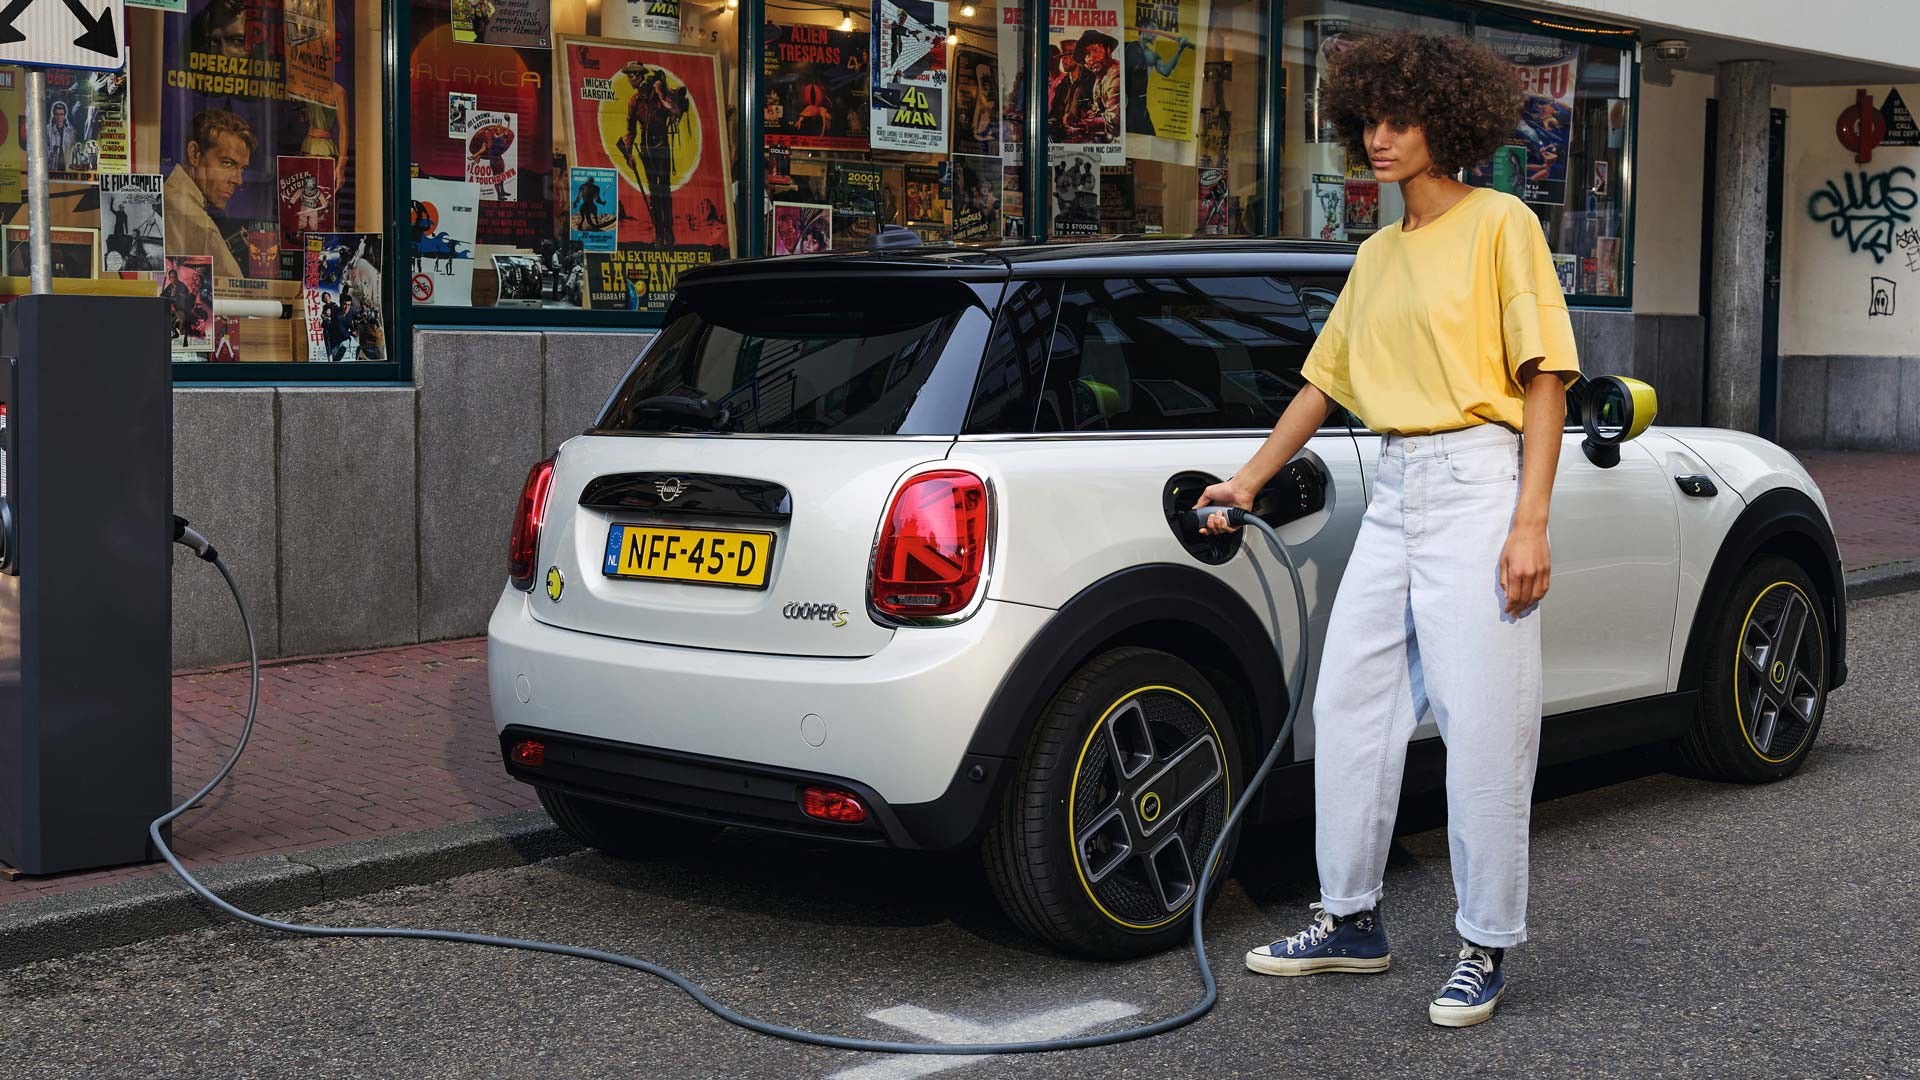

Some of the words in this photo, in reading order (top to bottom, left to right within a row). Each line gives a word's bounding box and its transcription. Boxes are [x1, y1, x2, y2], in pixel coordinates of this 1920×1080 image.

[1067, 10, 1118, 26] MARIA
[791, 25, 829, 44] ALIEN
[778, 43, 841, 64] TRESPASS
[189, 52, 281, 79] OPERAZIONE
[167, 70, 288, 100] CONTROSPIONAG
[410, 64, 541, 88] ALAXICA
[585, 78, 613, 89] MICKEY
[1511, 64, 1569, 99] G-FU
[582, 88, 615, 100] HARGITAY
[902, 86, 929, 109] 4D
[894, 109, 937, 127] MAN
[1004, 143, 1014, 152] BUD
[100, 174, 110, 191] LE
[111, 174, 129, 191] FILM
[131, 175, 162, 192] COMPLET
[280, 170, 310, 189] BUSTER
[475, 167, 516, 185] TOUCHDOWN
[1351, 169, 1376, 179] PASSIO
[1071, 223, 1098, 231] STOOGES
[627, 251, 697, 263] EXTRANJERO
[698, 251, 712, 263] EN
[592, 292, 617, 301] BARBARA
[1694, 482, 1701, 493] S
[607, 555, 618, 566] NL
[627, 533, 756, 577] NFF-45-D
[783, 602, 837, 620] COOPER
[832, 609, 849, 627] S
